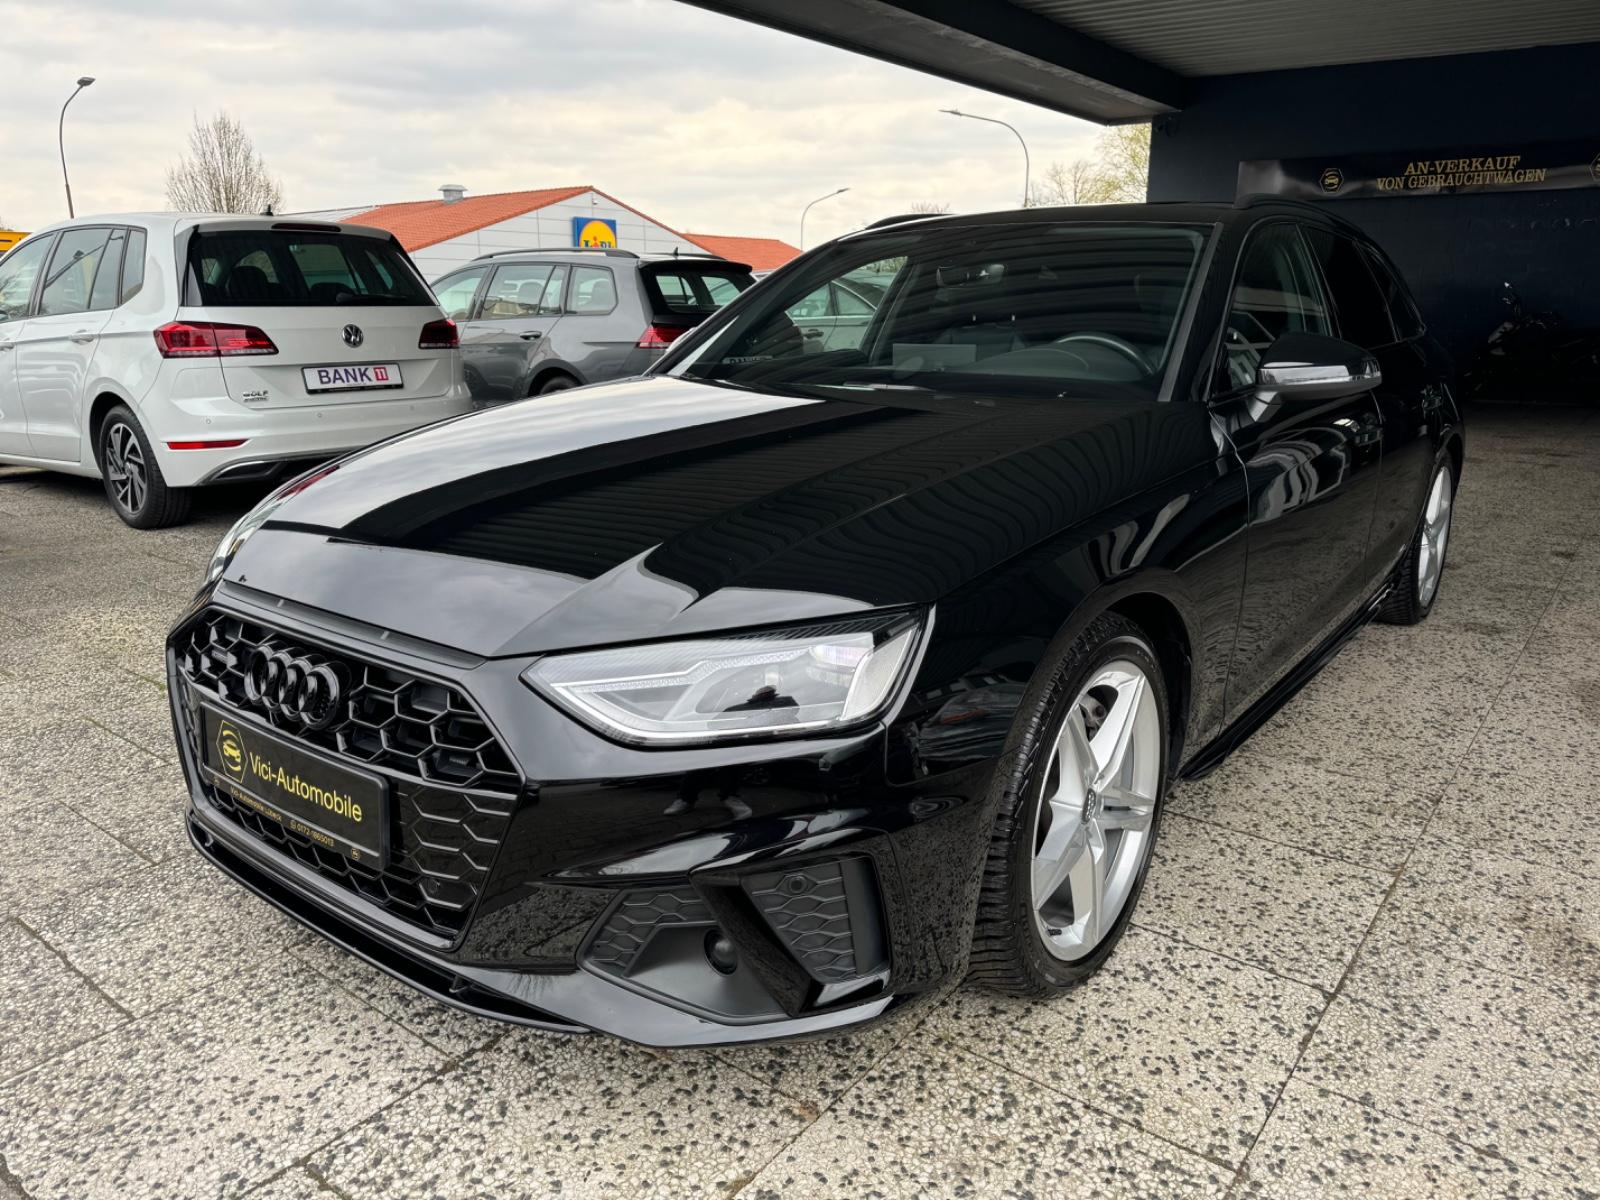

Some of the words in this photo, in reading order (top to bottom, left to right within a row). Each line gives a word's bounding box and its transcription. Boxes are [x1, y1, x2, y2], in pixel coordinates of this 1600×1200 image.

[1404, 155, 1521, 176] AN-VERKAUF
[1376, 177, 1405, 191] VON
[1408, 168, 1547, 189] GEBRAUCHTWAGEN
[317, 367, 372, 384] BANK
[249, 752, 363, 822] Vici-Automobile
